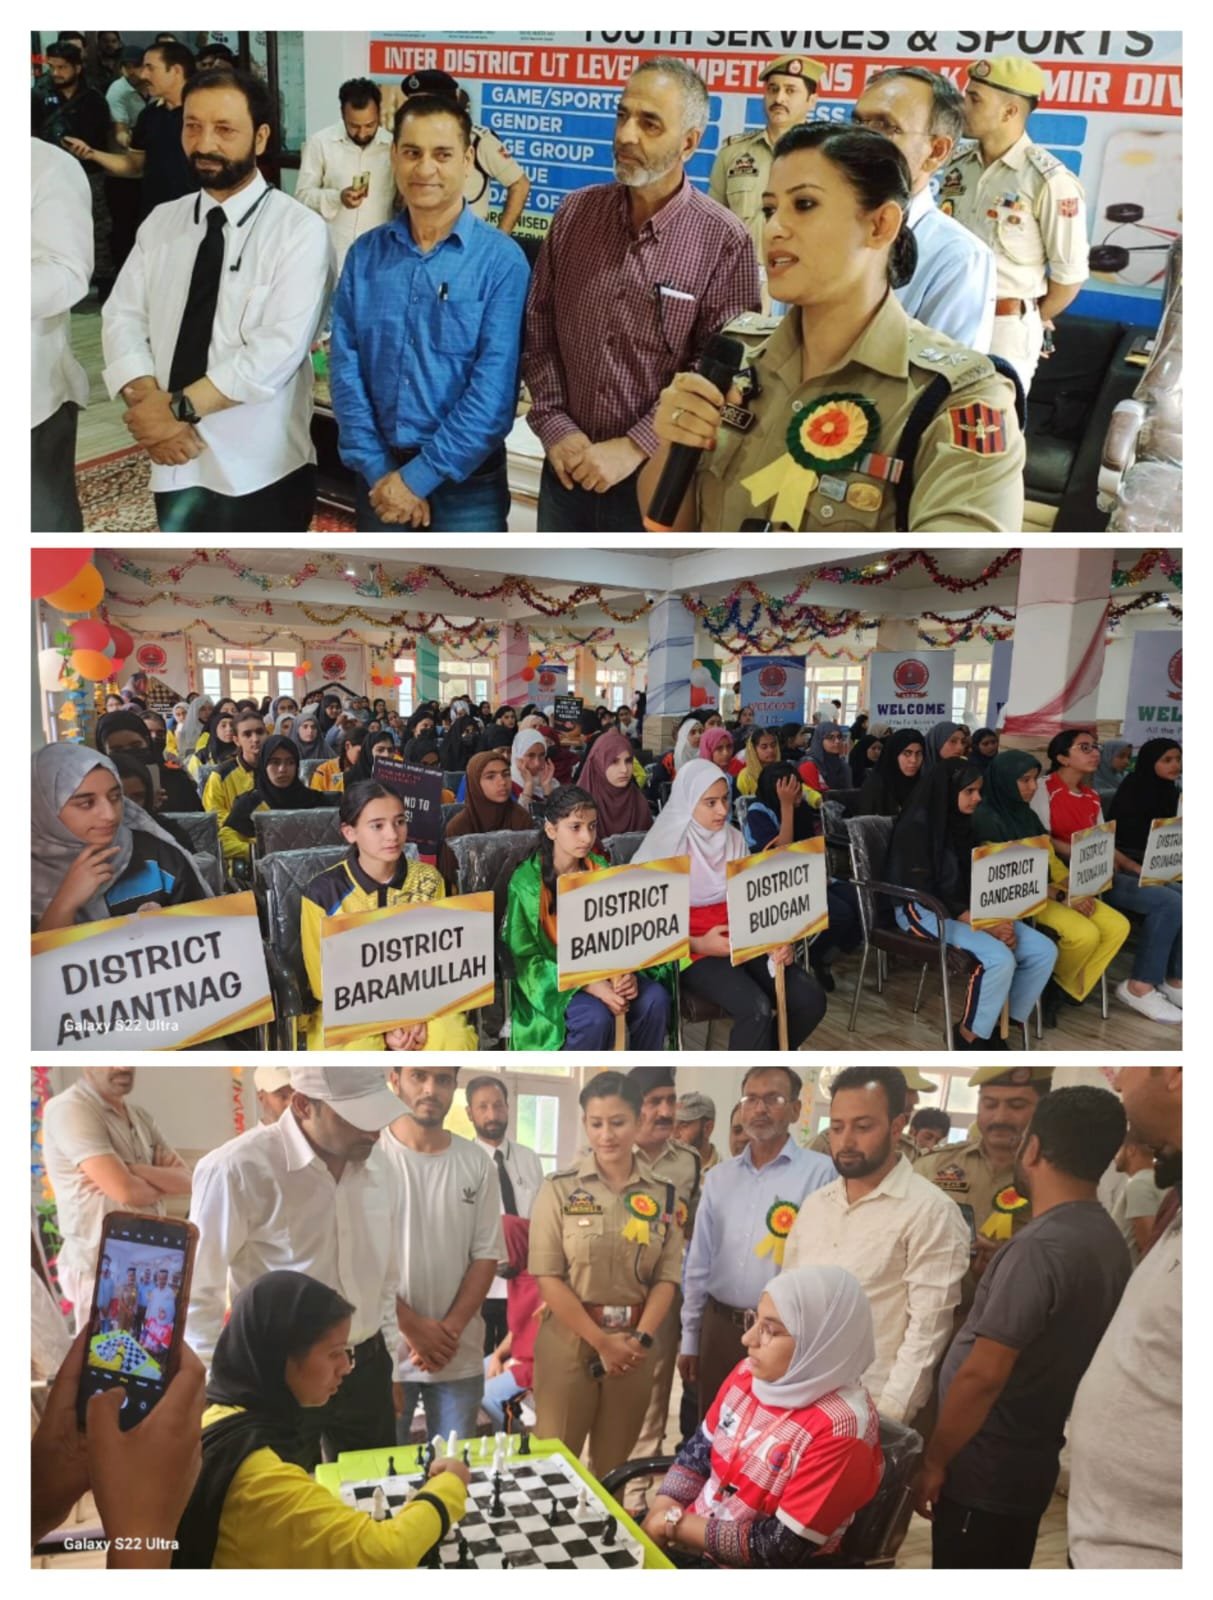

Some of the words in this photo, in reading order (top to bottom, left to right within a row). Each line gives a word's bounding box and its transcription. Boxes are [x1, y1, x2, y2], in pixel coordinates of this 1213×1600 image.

[706, 31, 890, 50] SERVICES
[907, 31, 937, 52] &
[956, 31, 1153, 56] SPORTS
[384, 46, 436, 70] INTER
[443, 48, 533, 75] DISTRICT
[540, 52, 569, 78] UT
[490, 112, 563, 132] GENDER
[502, 139, 525, 156] GE
[530, 141, 594, 161] GROUP
[536, 193, 560, 210] OF
[877, 703, 946, 715] WELCOME
[404, 796, 416, 809] NO
[419, 798, 430, 811] TO
[1080, 839, 1108, 864] DISTRICT
[746, 864, 810, 902] DISTRICT
[988, 858, 1035, 883] DISTRICT
[584, 884, 669, 922] DISTRICT
[980, 880, 1040, 908] GANDERBAL
[750, 894, 811, 934] BUDGAM
[361, 926, 464, 968] DISTRICT
[571, 914, 680, 960] BANDIPORA
[61, 931, 221, 996] DISTRICT
[334, 955, 487, 1011] BARAMULLAH
[57, 971, 242, 1046] ANANTNAG
